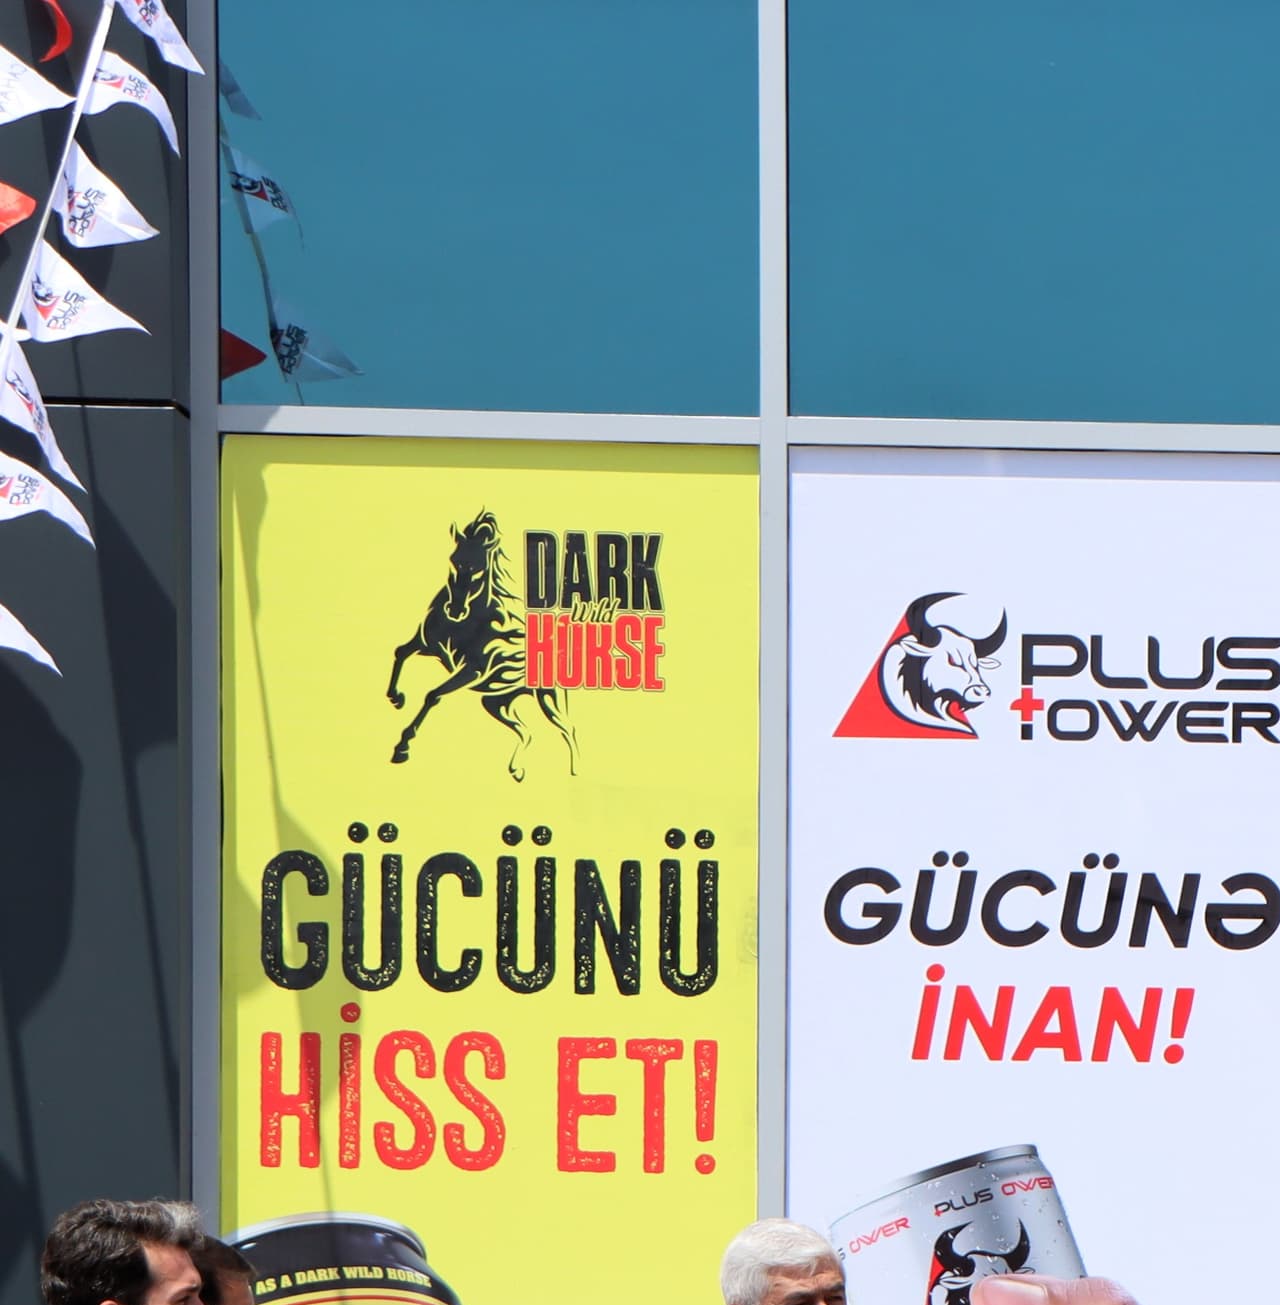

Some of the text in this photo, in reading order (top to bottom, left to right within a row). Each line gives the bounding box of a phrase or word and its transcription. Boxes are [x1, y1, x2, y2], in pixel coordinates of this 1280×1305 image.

[68, 187, 100, 235] PLUS
[47, 290, 80, 328] PLUS
[280, 323, 300, 374] PLUS
[9, 474, 31, 505] PLUS
[525, 531, 664, 611] DARK
[571, 599, 621, 623] Wild
[525, 613, 665, 691] HORSE
[260, 821, 719, 996] GÜCÜNÜ
[911, 963, 1195, 1064] İNAN!
[260, 1002, 718, 1175] HİSS ET!
[933, 1188, 994, 1217] PLUS
[255, 1266, 432, 1295] AS A DARK WILD HORSE
